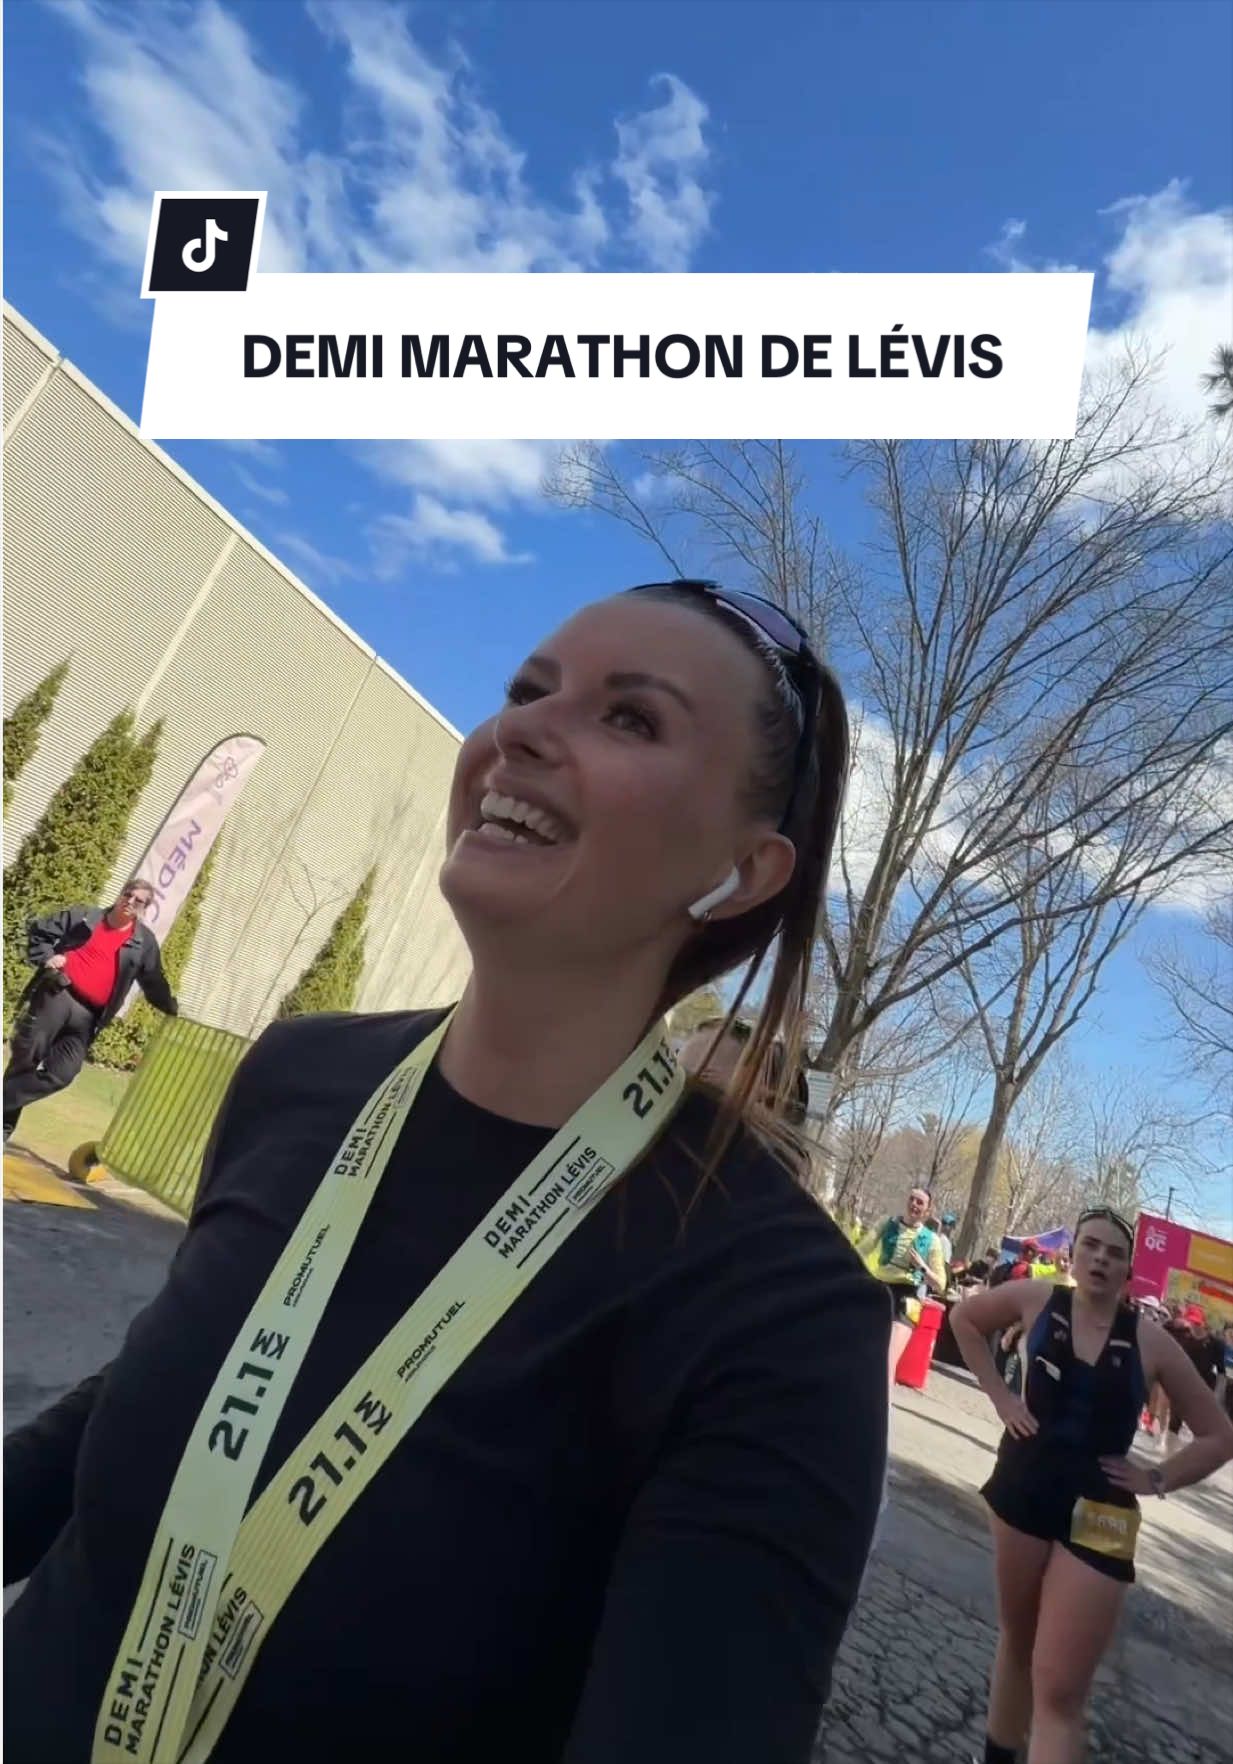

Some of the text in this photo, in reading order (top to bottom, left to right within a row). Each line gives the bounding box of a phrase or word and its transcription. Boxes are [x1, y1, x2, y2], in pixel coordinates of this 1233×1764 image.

[334, 1127, 368, 1176] DEMI
[484, 1193, 532, 1249] DEMI
[498, 1146, 598, 1259] MARATHON LÉVIS
[283, 1223, 331, 1307] PROMUTUEL
[397, 1300, 466, 1378] PROMUTUEL
[208, 1327, 290, 1462] 21.1 KM
[288, 1389, 394, 1527] 21.1 KM
[124, 1543, 196, 1756] MARATHON LÉVIS
[214, 1586, 248, 1645] LÉVIS
[103, 1657, 145, 1747] DEMI
